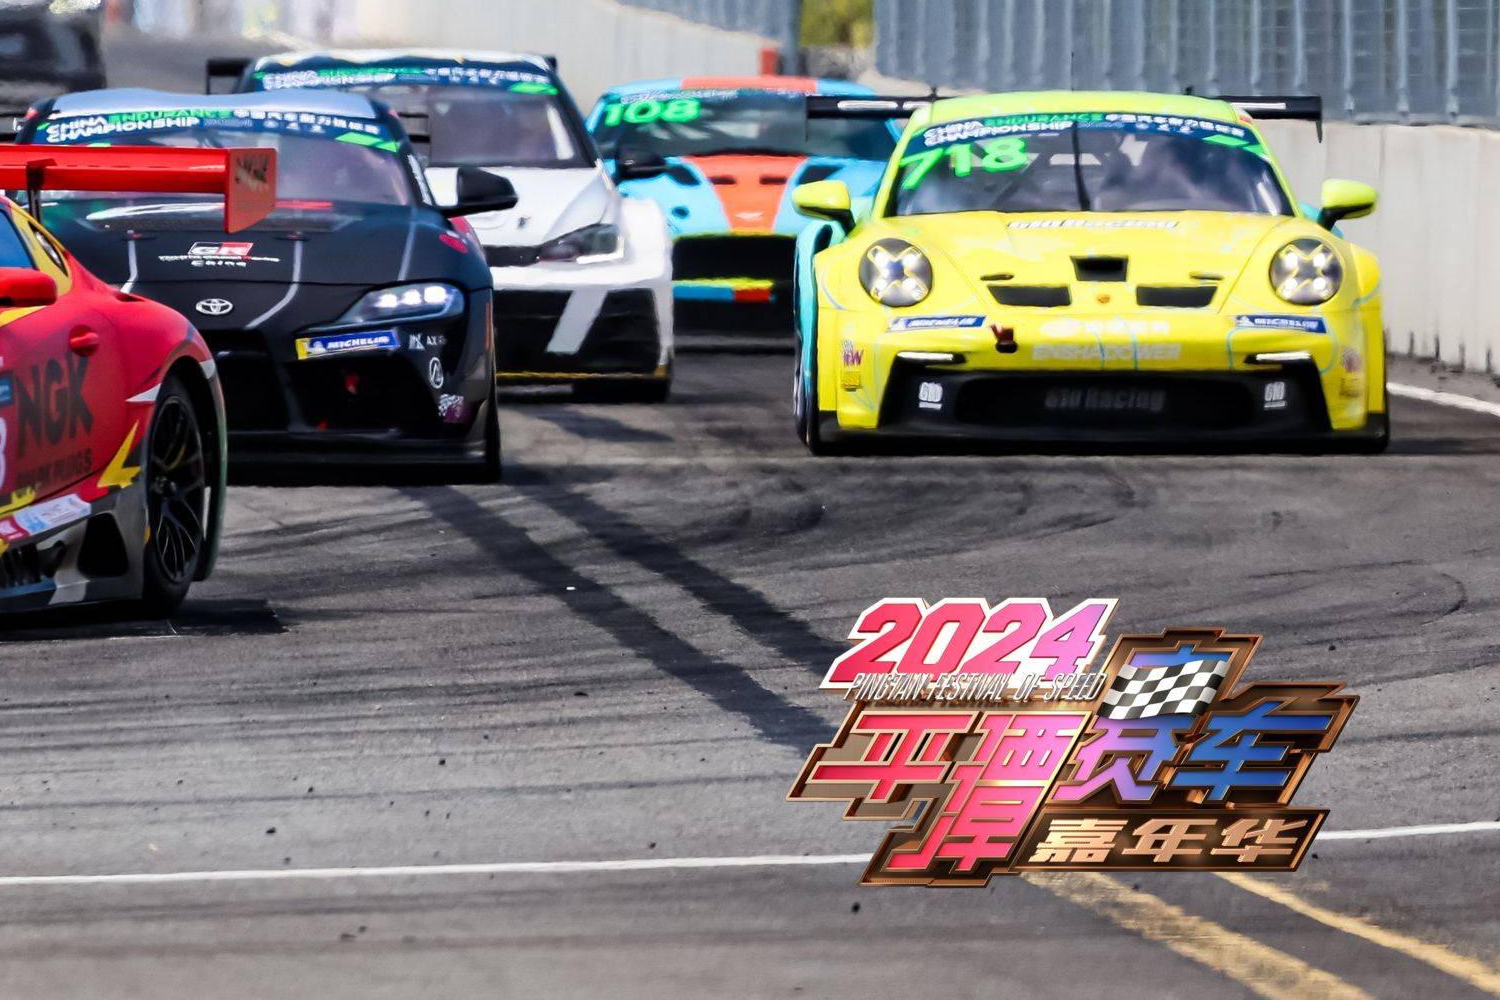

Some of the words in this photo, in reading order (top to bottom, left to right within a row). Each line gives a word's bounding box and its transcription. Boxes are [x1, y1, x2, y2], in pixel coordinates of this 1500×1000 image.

[605, 98, 701, 127] 108
[900, 137, 1029, 190] 718
[14, 352, 94, 459] NGK
